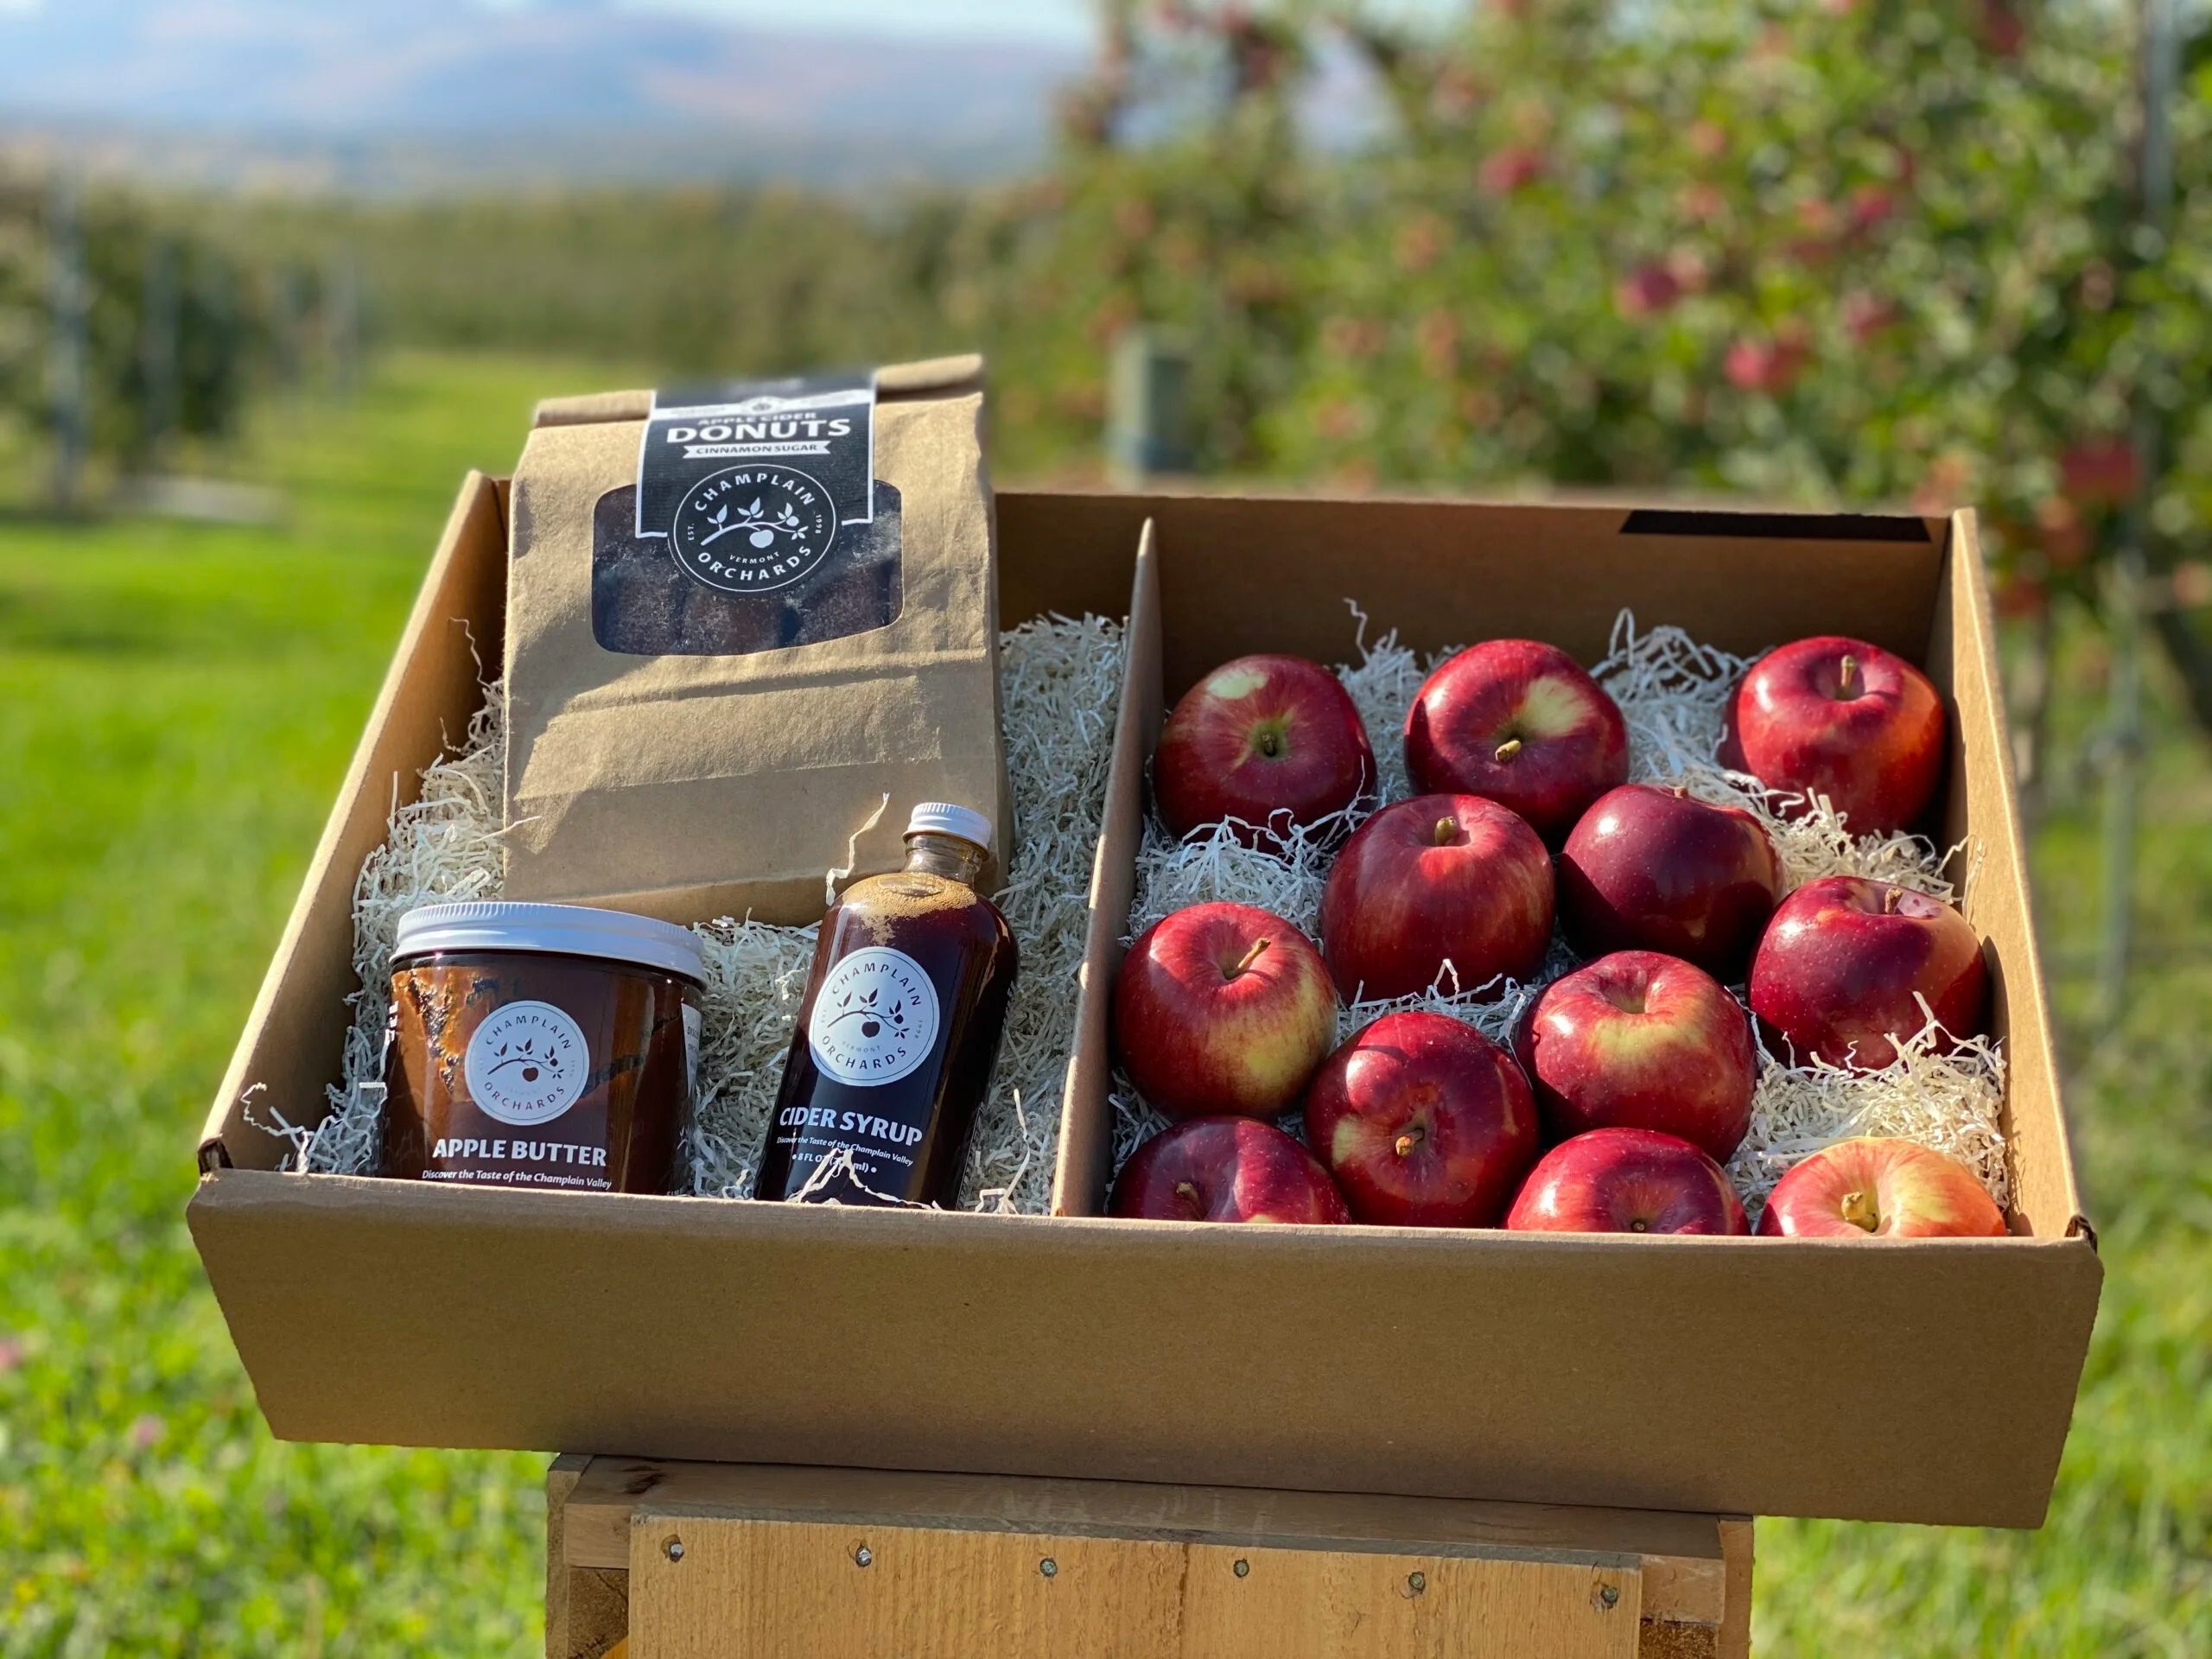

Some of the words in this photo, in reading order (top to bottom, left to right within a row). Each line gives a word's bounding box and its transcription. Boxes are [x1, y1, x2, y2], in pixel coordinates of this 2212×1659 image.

[666, 418, 851, 443] DONUTS
[697, 415, 759, 426] APPLE
[760, 412, 817, 422] CIDER
[696, 445, 772, 454] CINNAMON
[774, 443, 818, 452] SUGAR
[695, 473, 815, 512] CHAMPLAIN
[697, 545, 811, 581] ORCHARDS
[729, 551, 780, 564] VERMONT
[831, 963, 922, 1006] CHAMPLAIN
[486, 1015, 573, 1050] CHAMPLAIN
[822, 1035, 906, 1070] ORCHARDS
[484, 1082, 565, 1110] ORCHARDS
[779, 1106, 837, 1128] CIDER
[839, 1111, 923, 1147] SYRUP
[432, 1138, 507, 1159] APPLE
[511, 1141, 607, 1166] BUTTER
[798, 1153, 804, 1161] 8
[804, 1153, 814, 1162] FL
[809, 1136, 827, 1147] Taste
[828, 1139, 837, 1148] of
[836, 1141, 850, 1150] the
[850, 1143, 892, 1160] Champlain
[892, 1153, 914, 1167] Valley
[422, 1169, 457, 1180] Discover
[458, 1169, 474, 1179] the
[476, 1169, 501, 1181] Taste
[502, 1170, 515, 1183] of
[516, 1171, 532, 1182] the
[533, 1172, 585, 1187] Champlain
[586, 1177, 613, 1191] Valley
